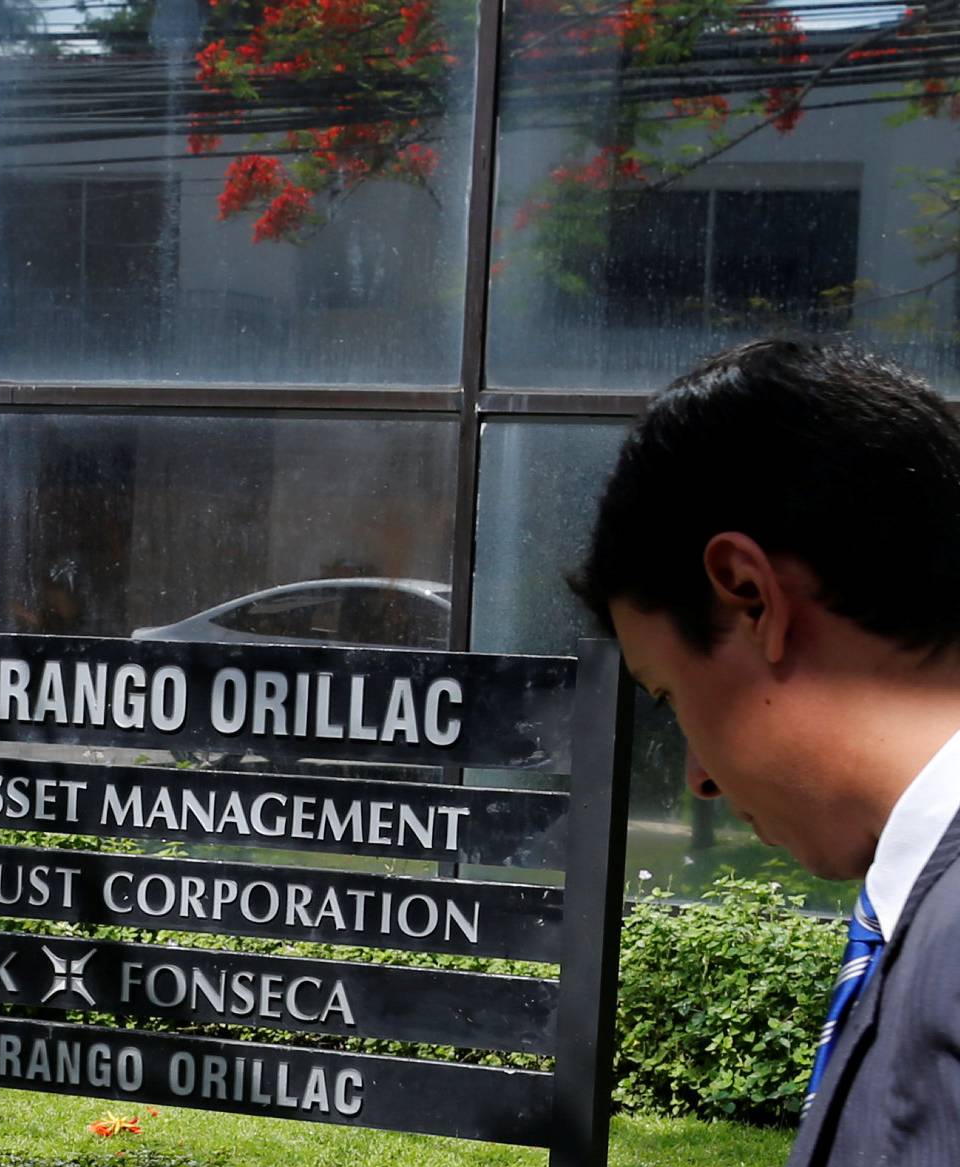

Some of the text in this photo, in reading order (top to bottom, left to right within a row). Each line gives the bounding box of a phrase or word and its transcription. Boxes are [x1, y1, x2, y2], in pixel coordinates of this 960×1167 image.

[210, 667, 464, 747] ORILLAC
[100, 783, 470, 851] MANAGEMENT
[103, 871, 480, 944] CORPORATION
[121, 961, 356, 1026] FONSECA
[169, 1050, 364, 1117] ORILLAC
